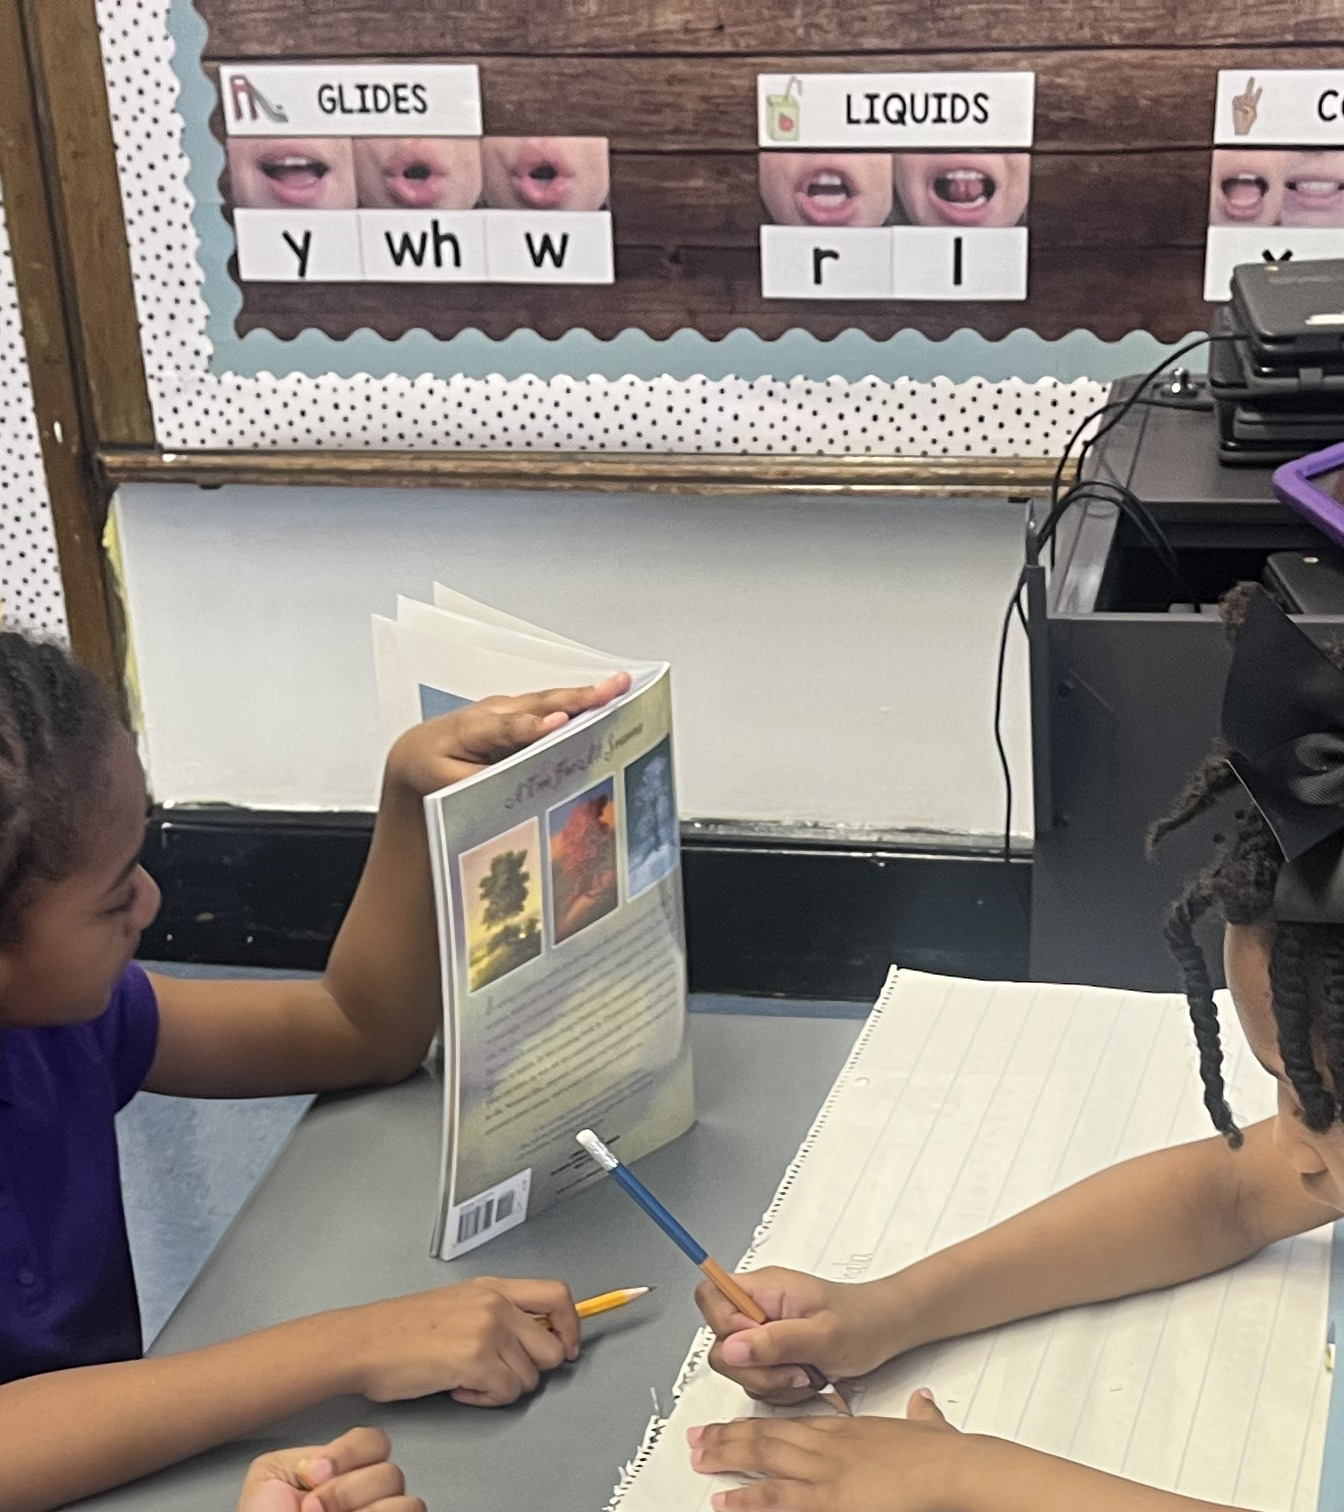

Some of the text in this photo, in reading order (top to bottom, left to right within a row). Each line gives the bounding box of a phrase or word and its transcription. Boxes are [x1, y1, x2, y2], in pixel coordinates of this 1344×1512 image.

[317, 83, 428, 115] GLIDES
[846, 93, 990, 126] LIQUIDS
[282, 218, 569, 278] y wh w
[813, 246, 840, 285] r
